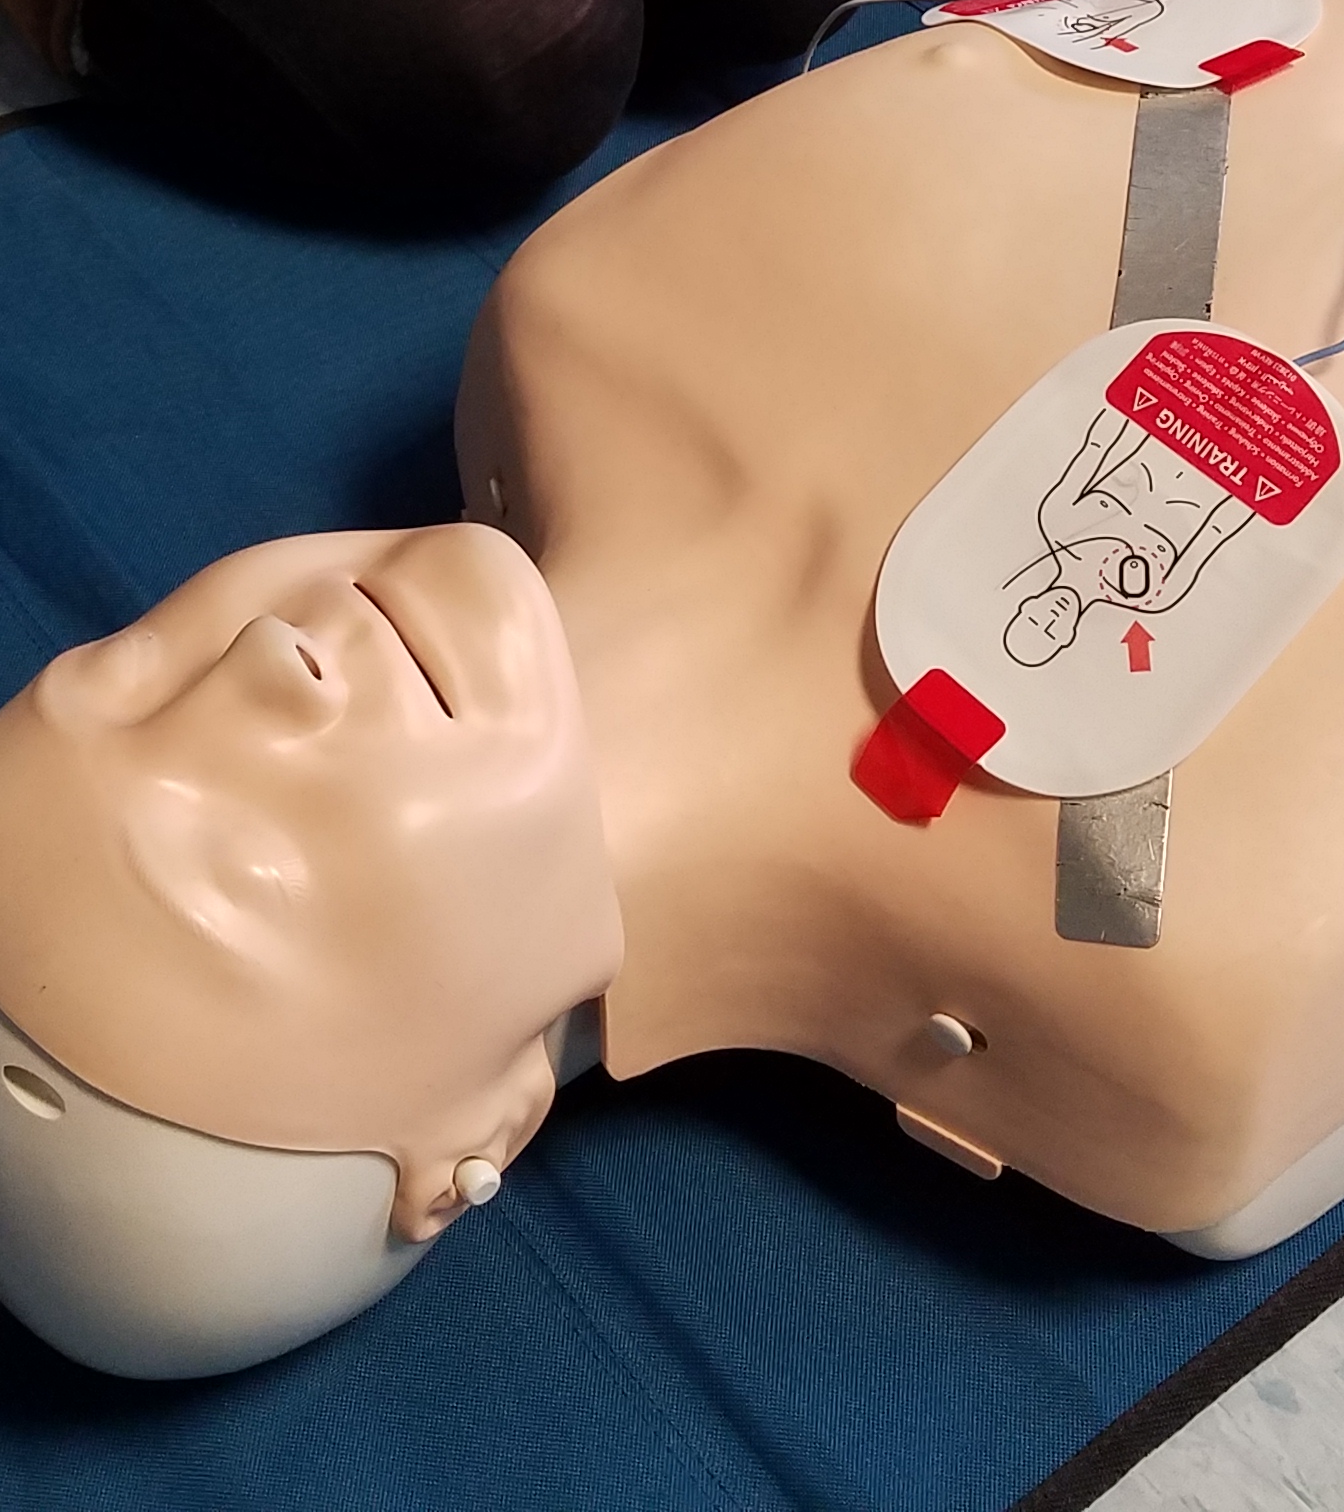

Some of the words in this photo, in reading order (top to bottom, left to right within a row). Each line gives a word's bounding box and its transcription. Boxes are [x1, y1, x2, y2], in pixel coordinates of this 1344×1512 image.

[1197, 405, 1222, 429] Training
[1214, 404, 1256, 437] Treinamento
[1229, 397, 1274, 434] Undervisning
[1156, 408, 1247, 485] TRAINING
[1229, 428, 1260, 455] Schulung
[1263, 438, 1319, 480] Addestramento
[1266, 456, 1303, 487] Formation
